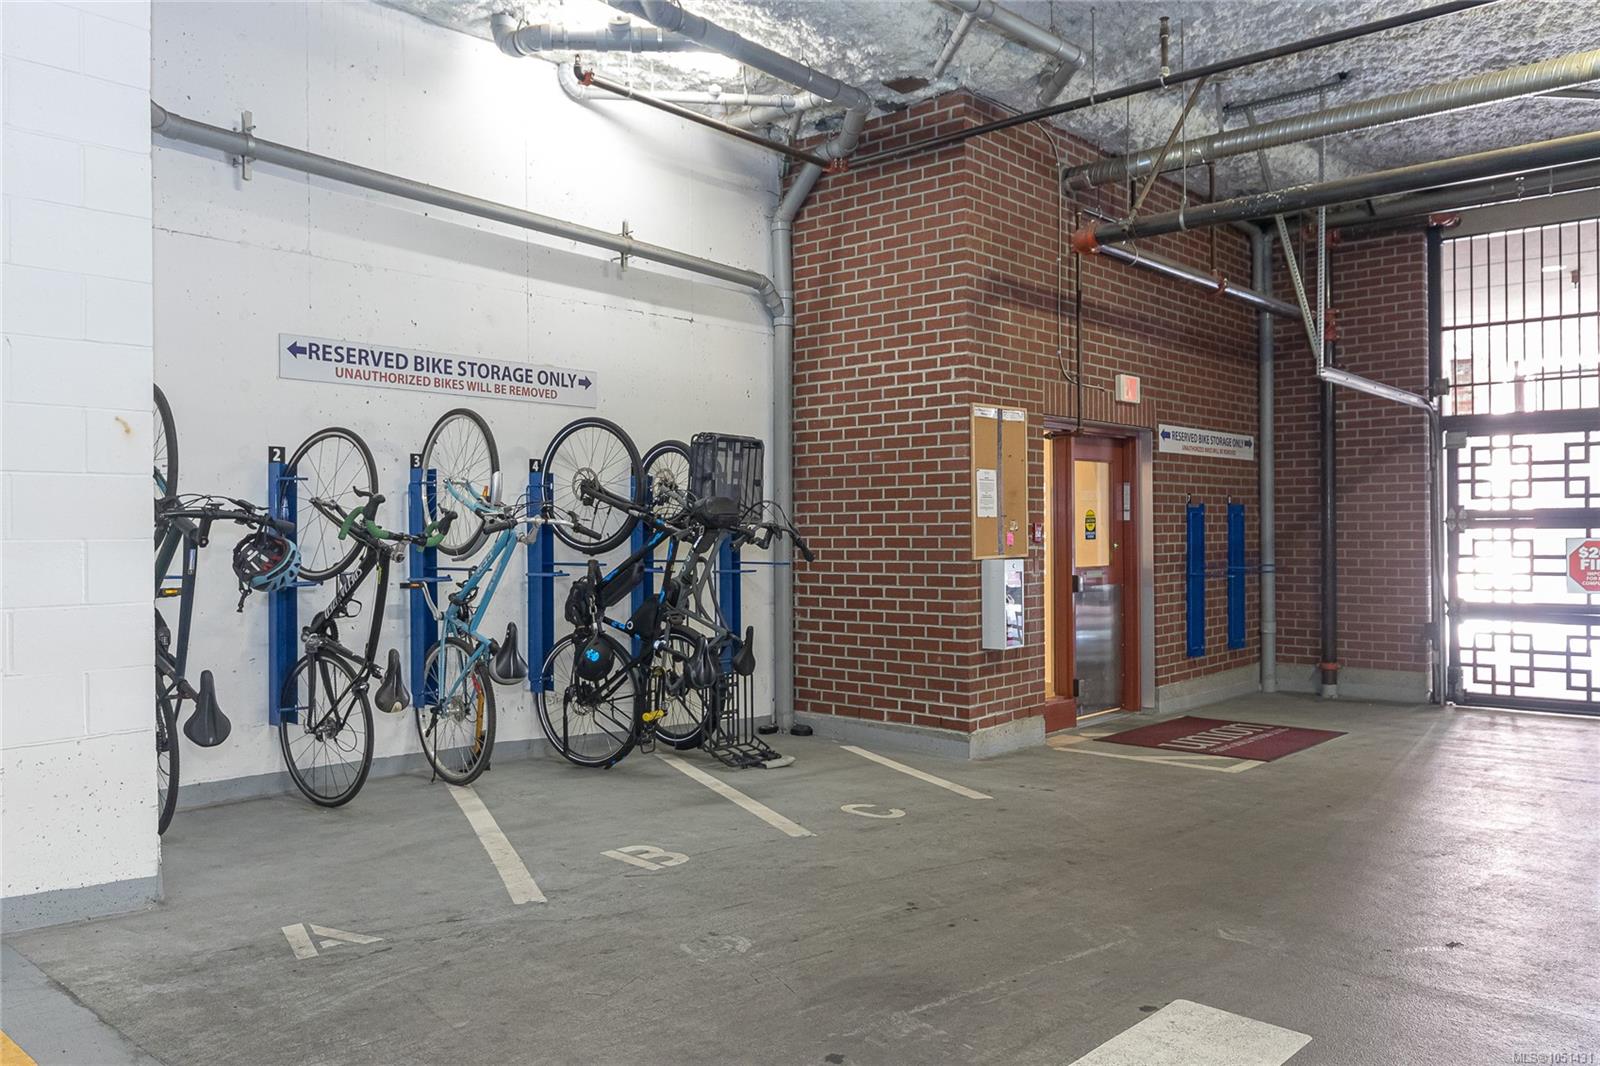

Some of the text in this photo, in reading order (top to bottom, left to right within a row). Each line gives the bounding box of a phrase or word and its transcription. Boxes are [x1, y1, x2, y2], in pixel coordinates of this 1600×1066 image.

[308, 342, 577, 388] RESERVED BIKE STORAGE ONLY
[335, 367, 558, 400] UNAUTHORIZED BIKES WILL BE REMOVED
[1171, 430, 1198, 443] RESERVED
[1198, 433, 1210, 445] BIKE
[1210, 435, 1232, 447] STORAGE
[272, 448, 282, 462] 2
[413, 455, 421, 468] 3
[532, 460, 540, 472] 4
[1578, 545, 1600, 559] $2
[840, 803, 907, 819] C
[600, 845, 690, 871] B
[281, 923, 385, 960] A
